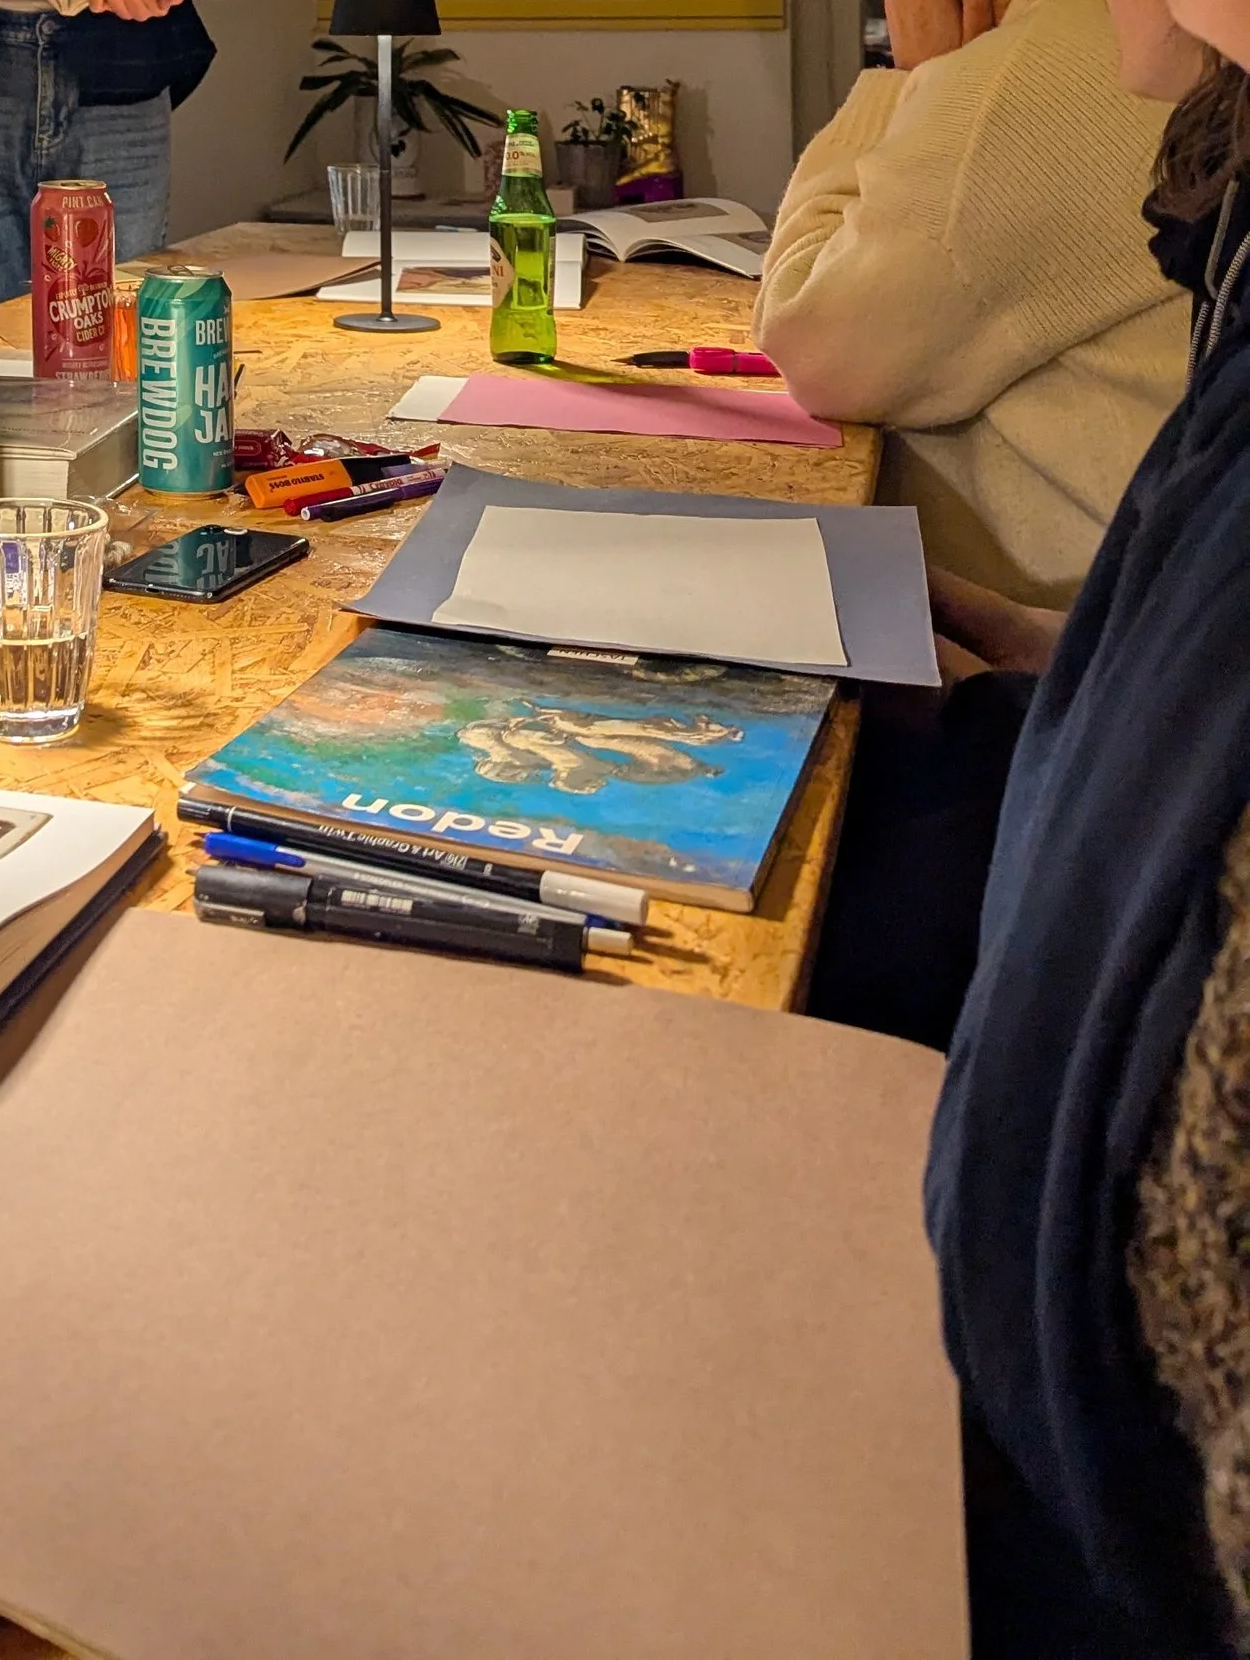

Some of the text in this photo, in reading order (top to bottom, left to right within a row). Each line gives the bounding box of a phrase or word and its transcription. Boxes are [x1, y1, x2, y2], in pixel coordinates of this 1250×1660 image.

[62, 196, 85, 208] PINT
[49, 285, 114, 322] CRUMPTON
[73, 311, 104, 329] OAKS
[76, 328, 98, 342] CIDER
[140, 316, 178, 471] BREWDOG
[194, 361, 230, 408] HA
[194, 406, 232, 444] JA
[268, 477, 292, 491] BOSS
[317, 824, 357, 842] Twin
[341, 792, 585, 856] Redon
[358, 830, 409, 854] Graphic
[409, 843, 421, 855] &
[419, 845, 443, 861] Art
